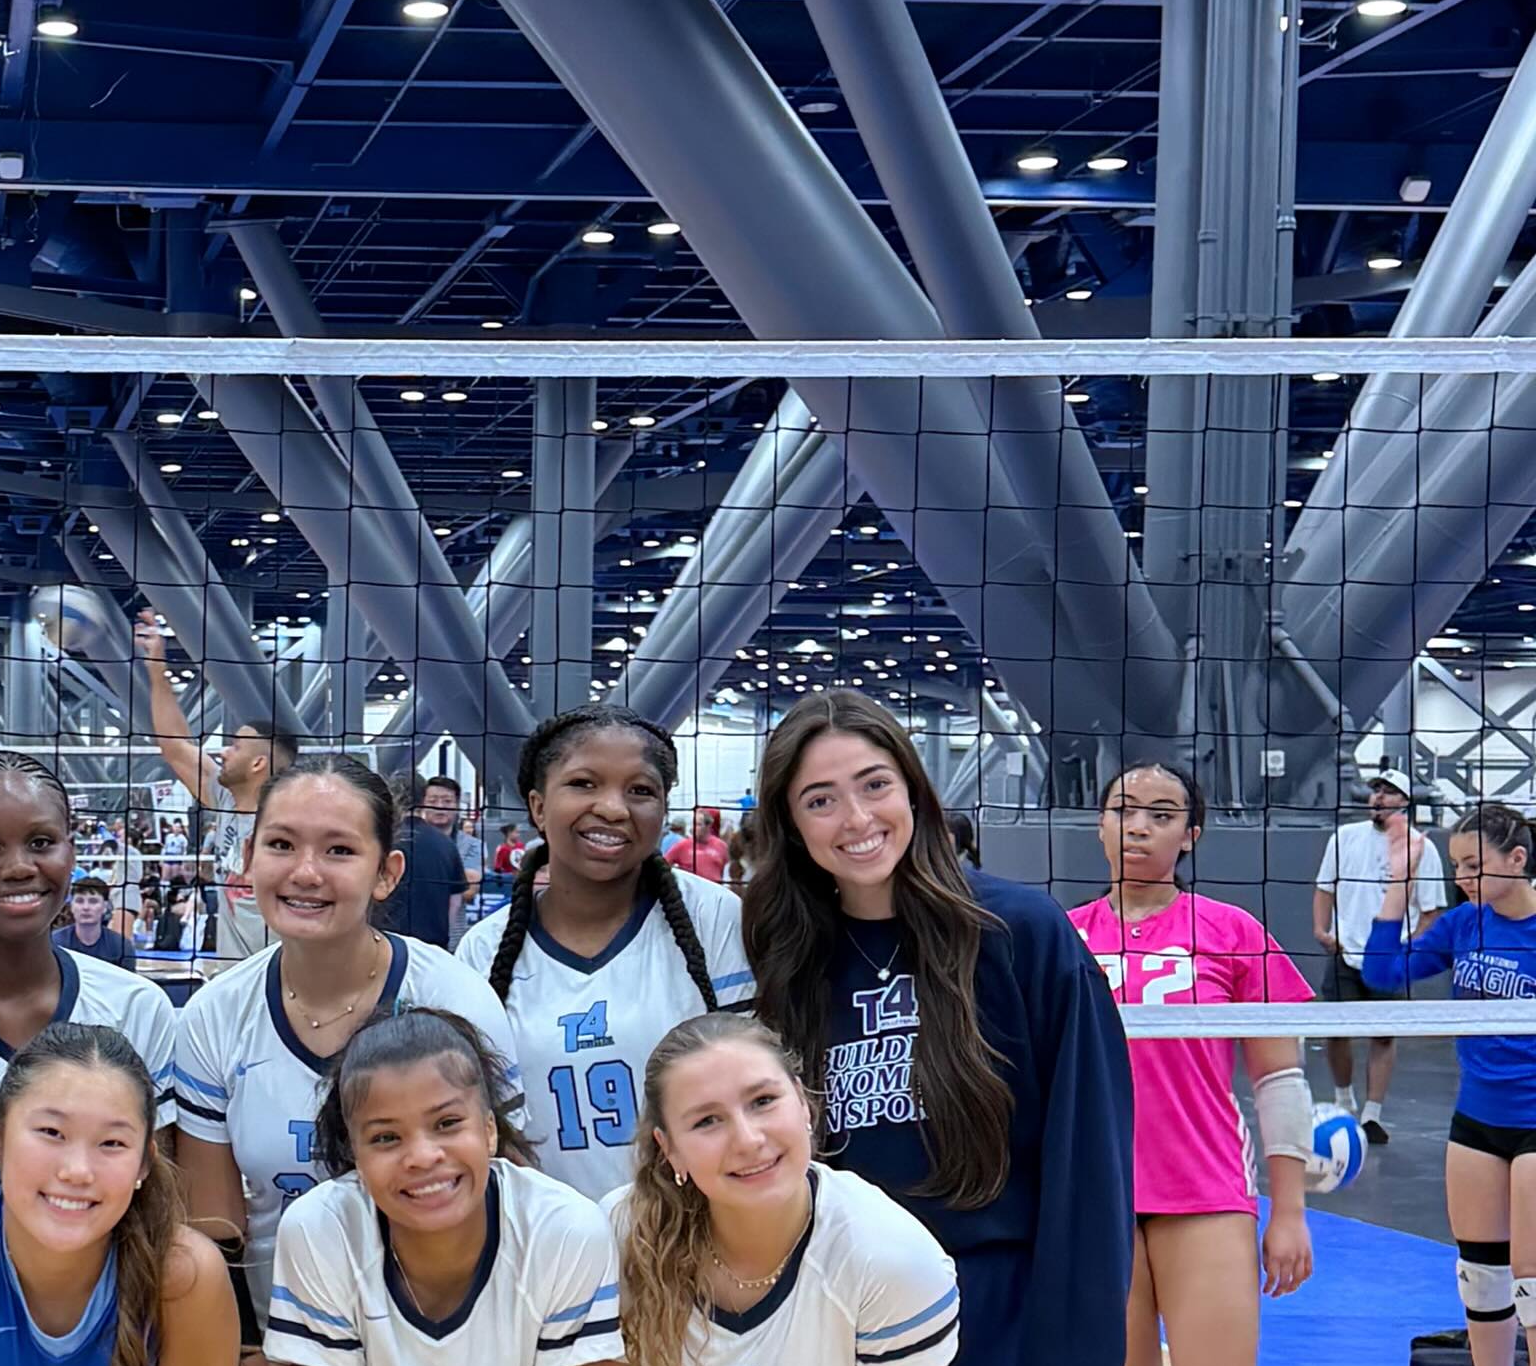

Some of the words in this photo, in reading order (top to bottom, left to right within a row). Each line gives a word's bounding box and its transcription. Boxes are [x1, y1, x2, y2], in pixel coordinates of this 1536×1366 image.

[853, 974, 919, 1035] T4
[1453, 957, 1536, 1000] MAGIC
[557, 1000, 609, 1054] T4
[548, 1059, 640, 1152] 19
